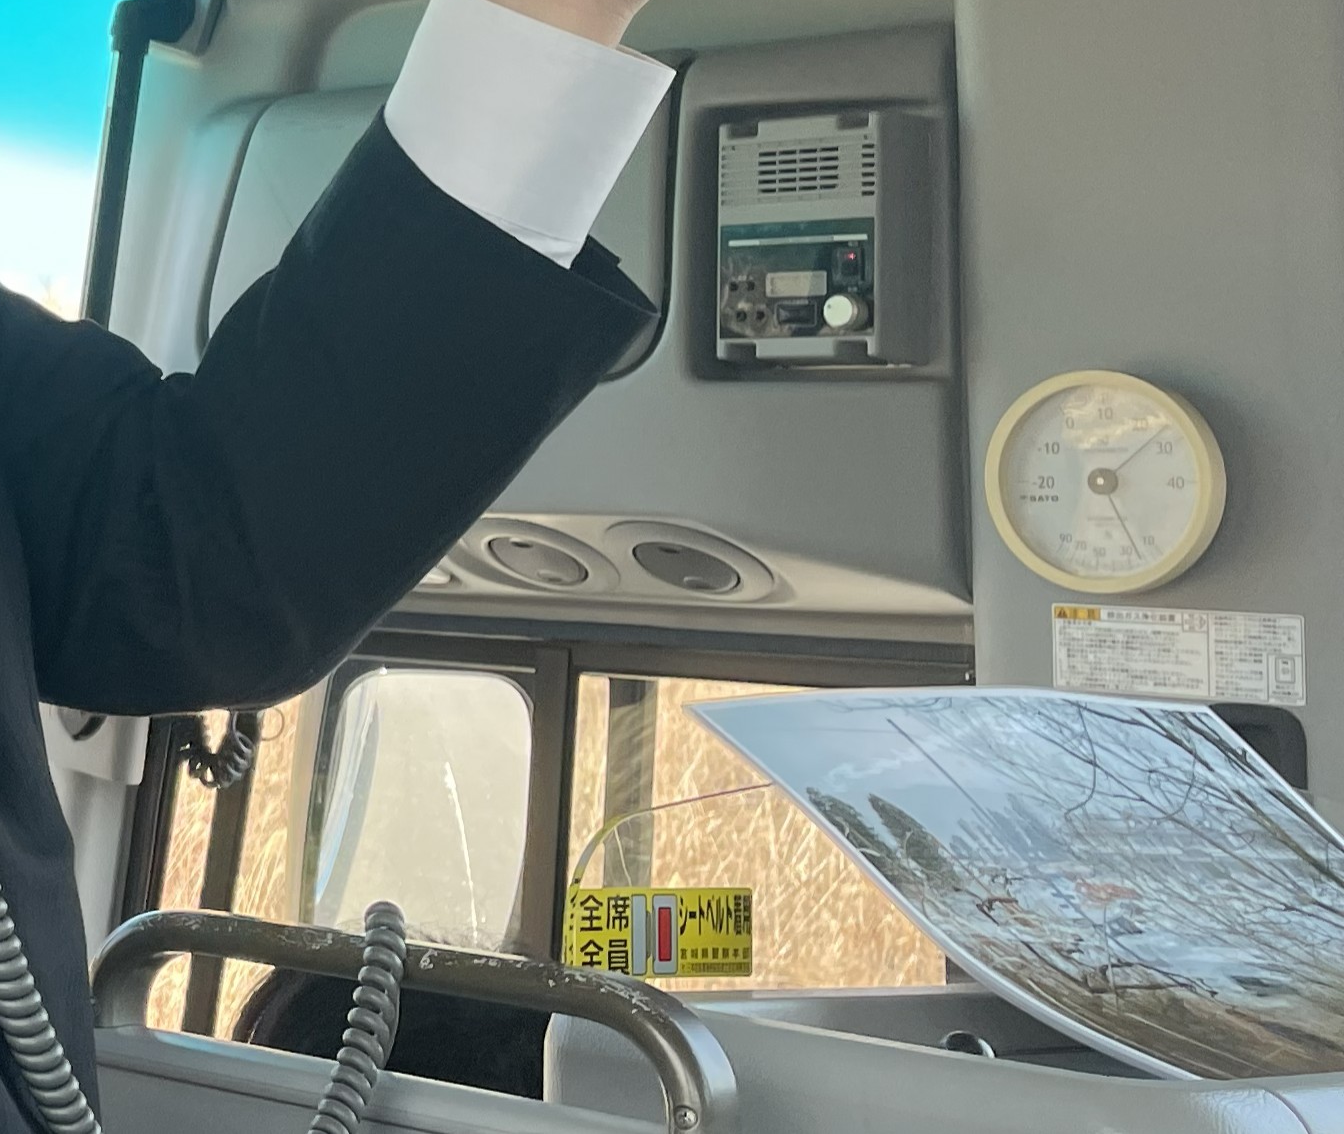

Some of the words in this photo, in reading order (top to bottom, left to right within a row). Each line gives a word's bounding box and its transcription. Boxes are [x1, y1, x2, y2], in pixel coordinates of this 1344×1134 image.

[1098, 407, 1112, 421] 10
[1167, 476, 1185, 490] 40
[1029, 494, 1059, 503] SATO
[579, 893, 630, 933] 全席
[580, 939, 631, 975] 全員
